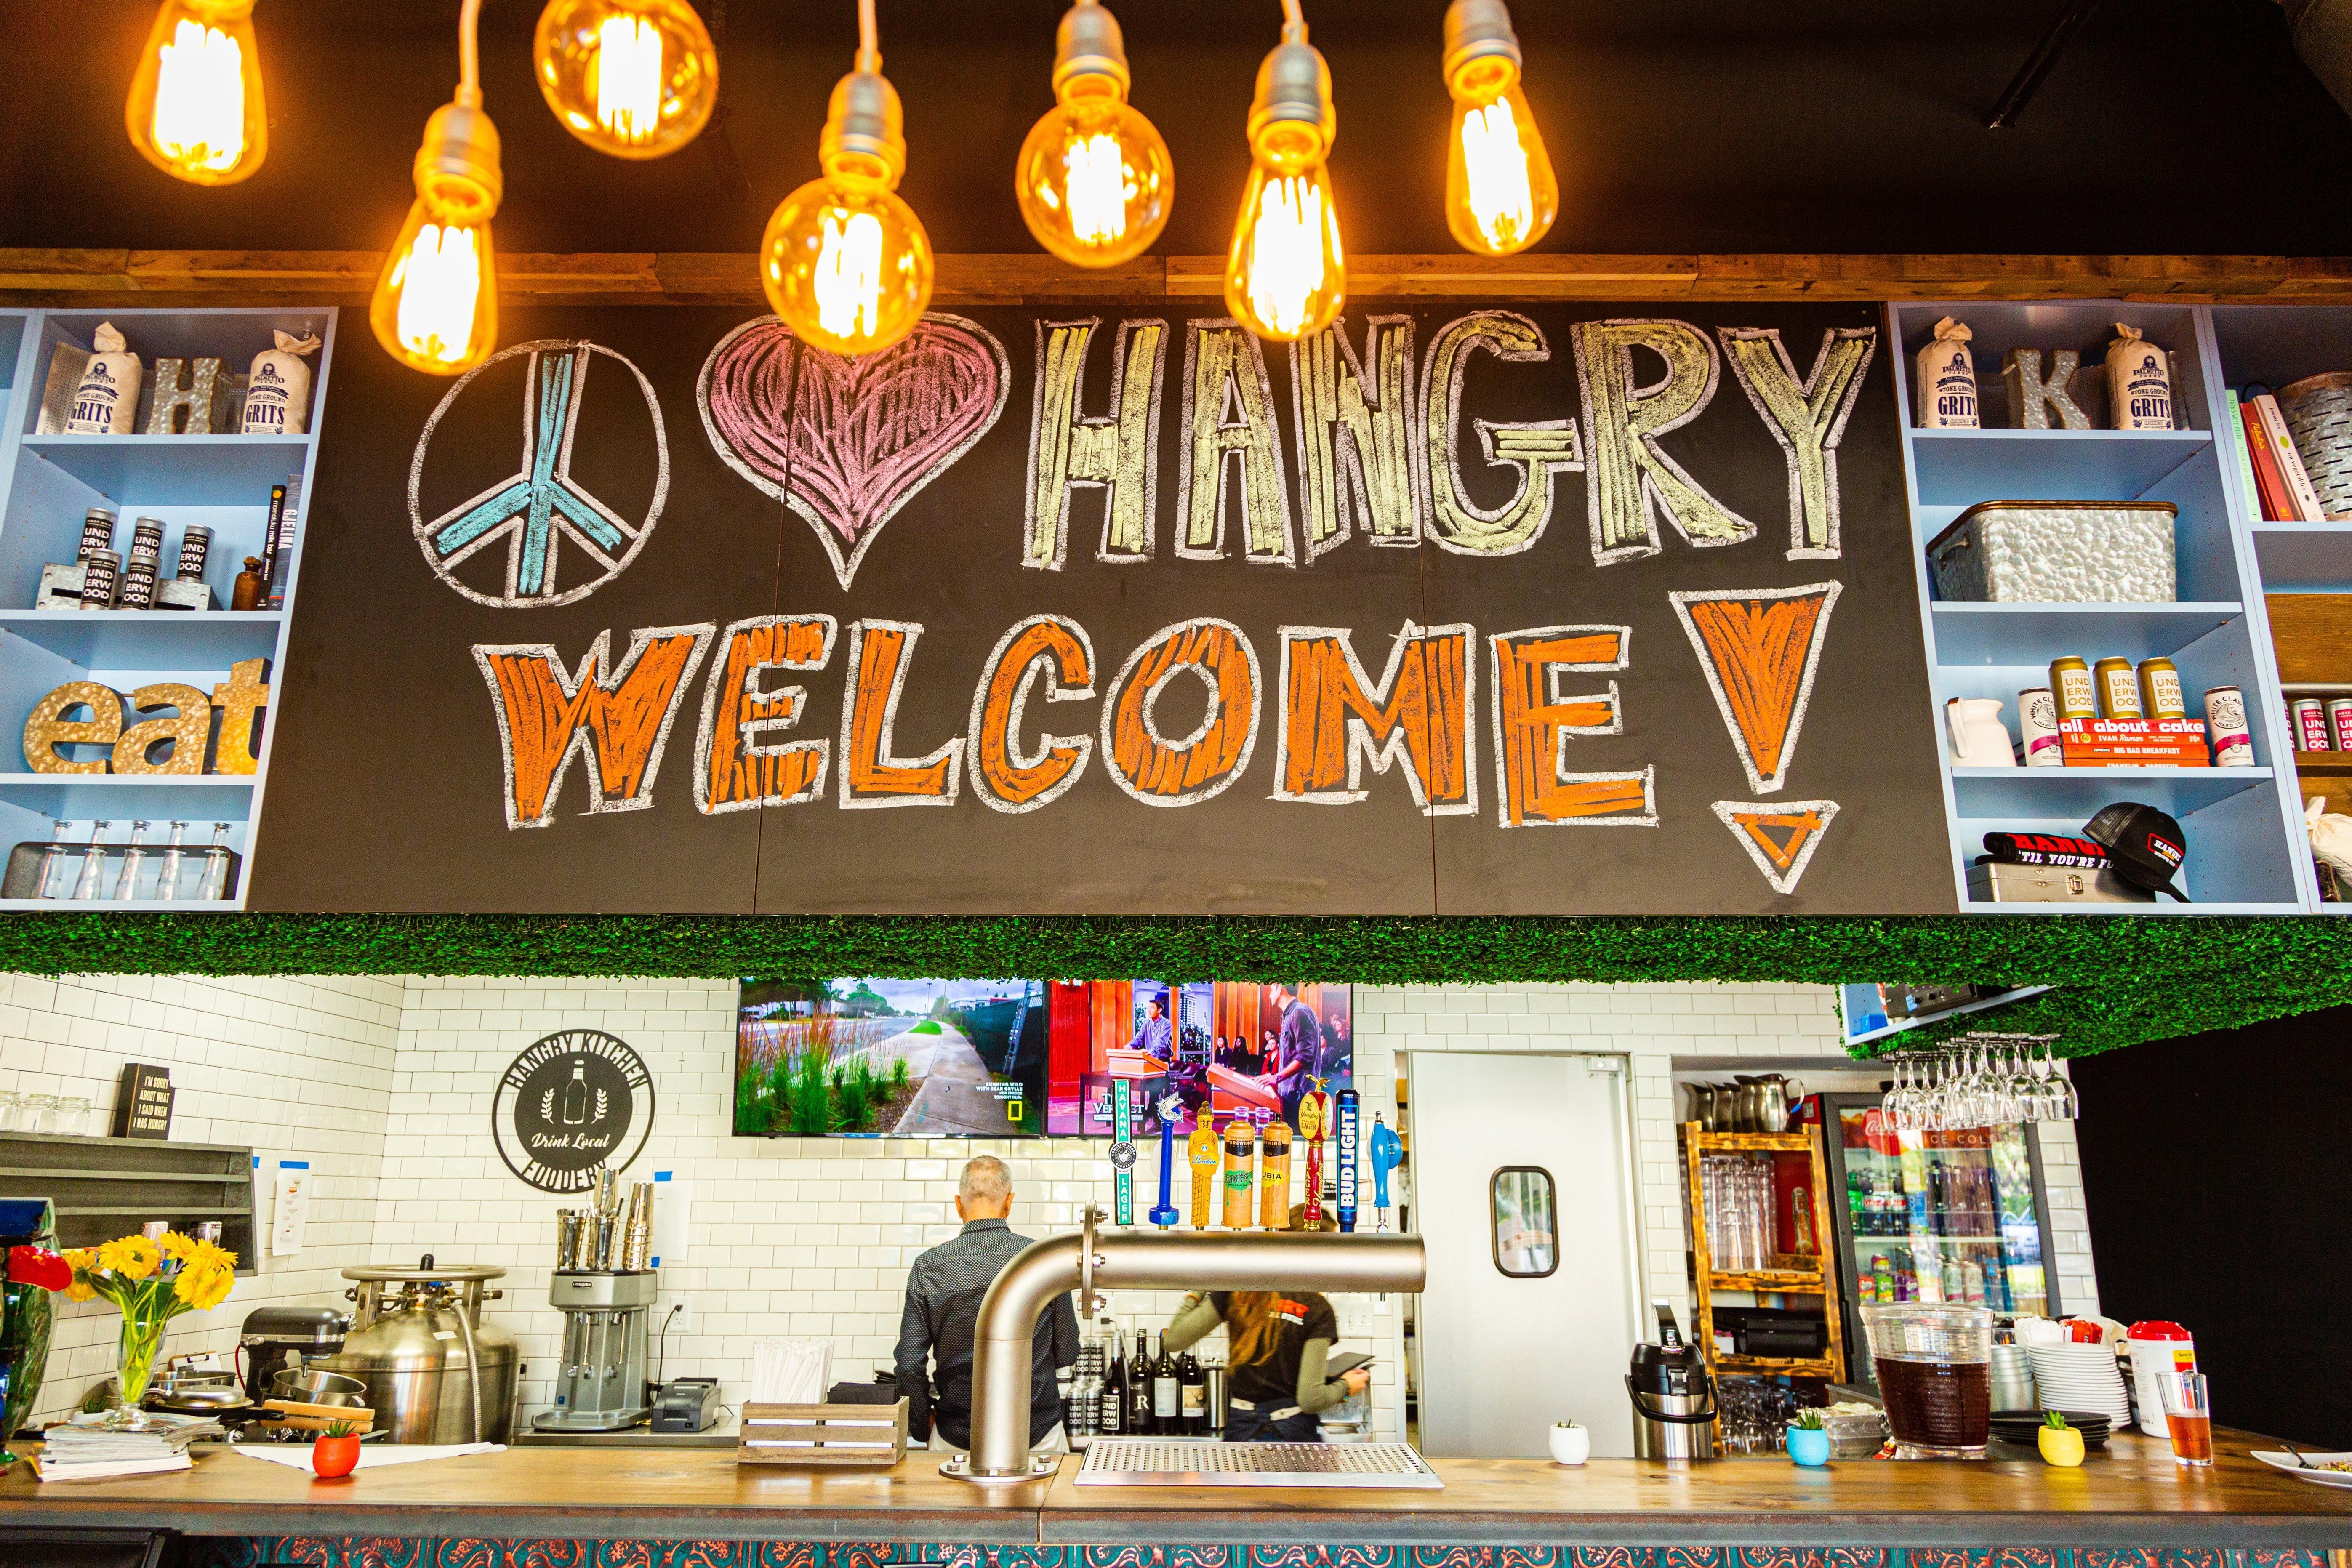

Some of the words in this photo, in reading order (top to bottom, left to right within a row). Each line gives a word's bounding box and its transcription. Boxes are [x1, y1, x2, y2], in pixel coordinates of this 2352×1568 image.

[1942, 365, 1971, 374] PALMETTO
[254, 374, 285, 383] PALMETTO
[263, 394, 285, 403] GROUND
[71, 402, 112, 423] GRITS
[1938, 396, 1977, 416] GRITS
[2131, 398, 2171, 418] GRITS
[246, 404, 285, 425] GRITS
[2269, 407, 2278, 423] jeremy
[1020, 309, 1878, 571] HANGRY
[2291, 461, 2306, 491] vegetables
[269, 500, 278, 530] momofuku
[85, 527, 109, 539] UND
[278, 509, 298, 549] GJELINA
[82, 537, 108, 548] ERW
[135, 536, 159, 547] UND
[133, 546, 157, 556] ERW
[182, 544, 205, 553] UND
[181, 553, 203, 562] ERW
[88, 569, 113, 579] UND
[178, 563, 202, 572] OOD
[85, 579, 112, 589] ERW
[128, 573, 153, 583] UND
[83, 589, 109, 599] OOD
[126, 583, 151, 594] ERW
[124, 593, 149, 603] OOD
[2065, 678, 2089, 686] UND
[2112, 678, 2135, 687] UND
[2156, 678, 2179, 687] UND
[2068, 697, 2092, 706] OOD
[2116, 698, 2139, 706] OOD
[2030, 698, 2042, 719] WHITE
[2211, 699, 2221, 721] WHITE
[2222, 696, 2242, 706] CLAW
[23, 657, 272, 775] eat
[2060, 719, 2083, 732] all
[2094, 719, 2150, 732] about
[2159, 719, 2205, 733] cake
[2005, 833, 2106, 856] HANG
[2048, 854, 2095, 867] YOU'RE
[505, 1033, 573, 1090] HANGRY
[581, 1033, 648, 1090] KITCHEN
[144, 1076, 153, 1087] I'M
[153, 1077, 169, 1089] SORRY
[139, 1089, 156, 1102] ABOUT
[156, 1091, 170, 1103] WHAT
[138, 1103, 141, 1115] I
[141, 1104, 154, 1115] SAID
[154, 1105, 168, 1117] WHEN
[1119, 1084, 1127, 1137] HAVANA
[1300, 1109, 1318, 1120] Yuengling
[133, 1117, 136, 1128] I
[136, 1117, 148, 1129] WAS
[148, 1118, 168, 1131] HUNGRY
[1301, 1122, 1316, 1131] LAGER
[531, 1132, 570, 1148] Drink
[572, 1132, 610, 1150] Local
[1340, 1110, 1356, 1165] LIGHT
[1111, 1142, 1127, 1156] CONCRETE
[1192, 1155, 1217, 1165] Floridian
[1312, 1160, 1324, 1206] Yuengling
[1340, 1166, 1355, 1207] BUD
[1120, 1177, 1129, 1221] LAGER
